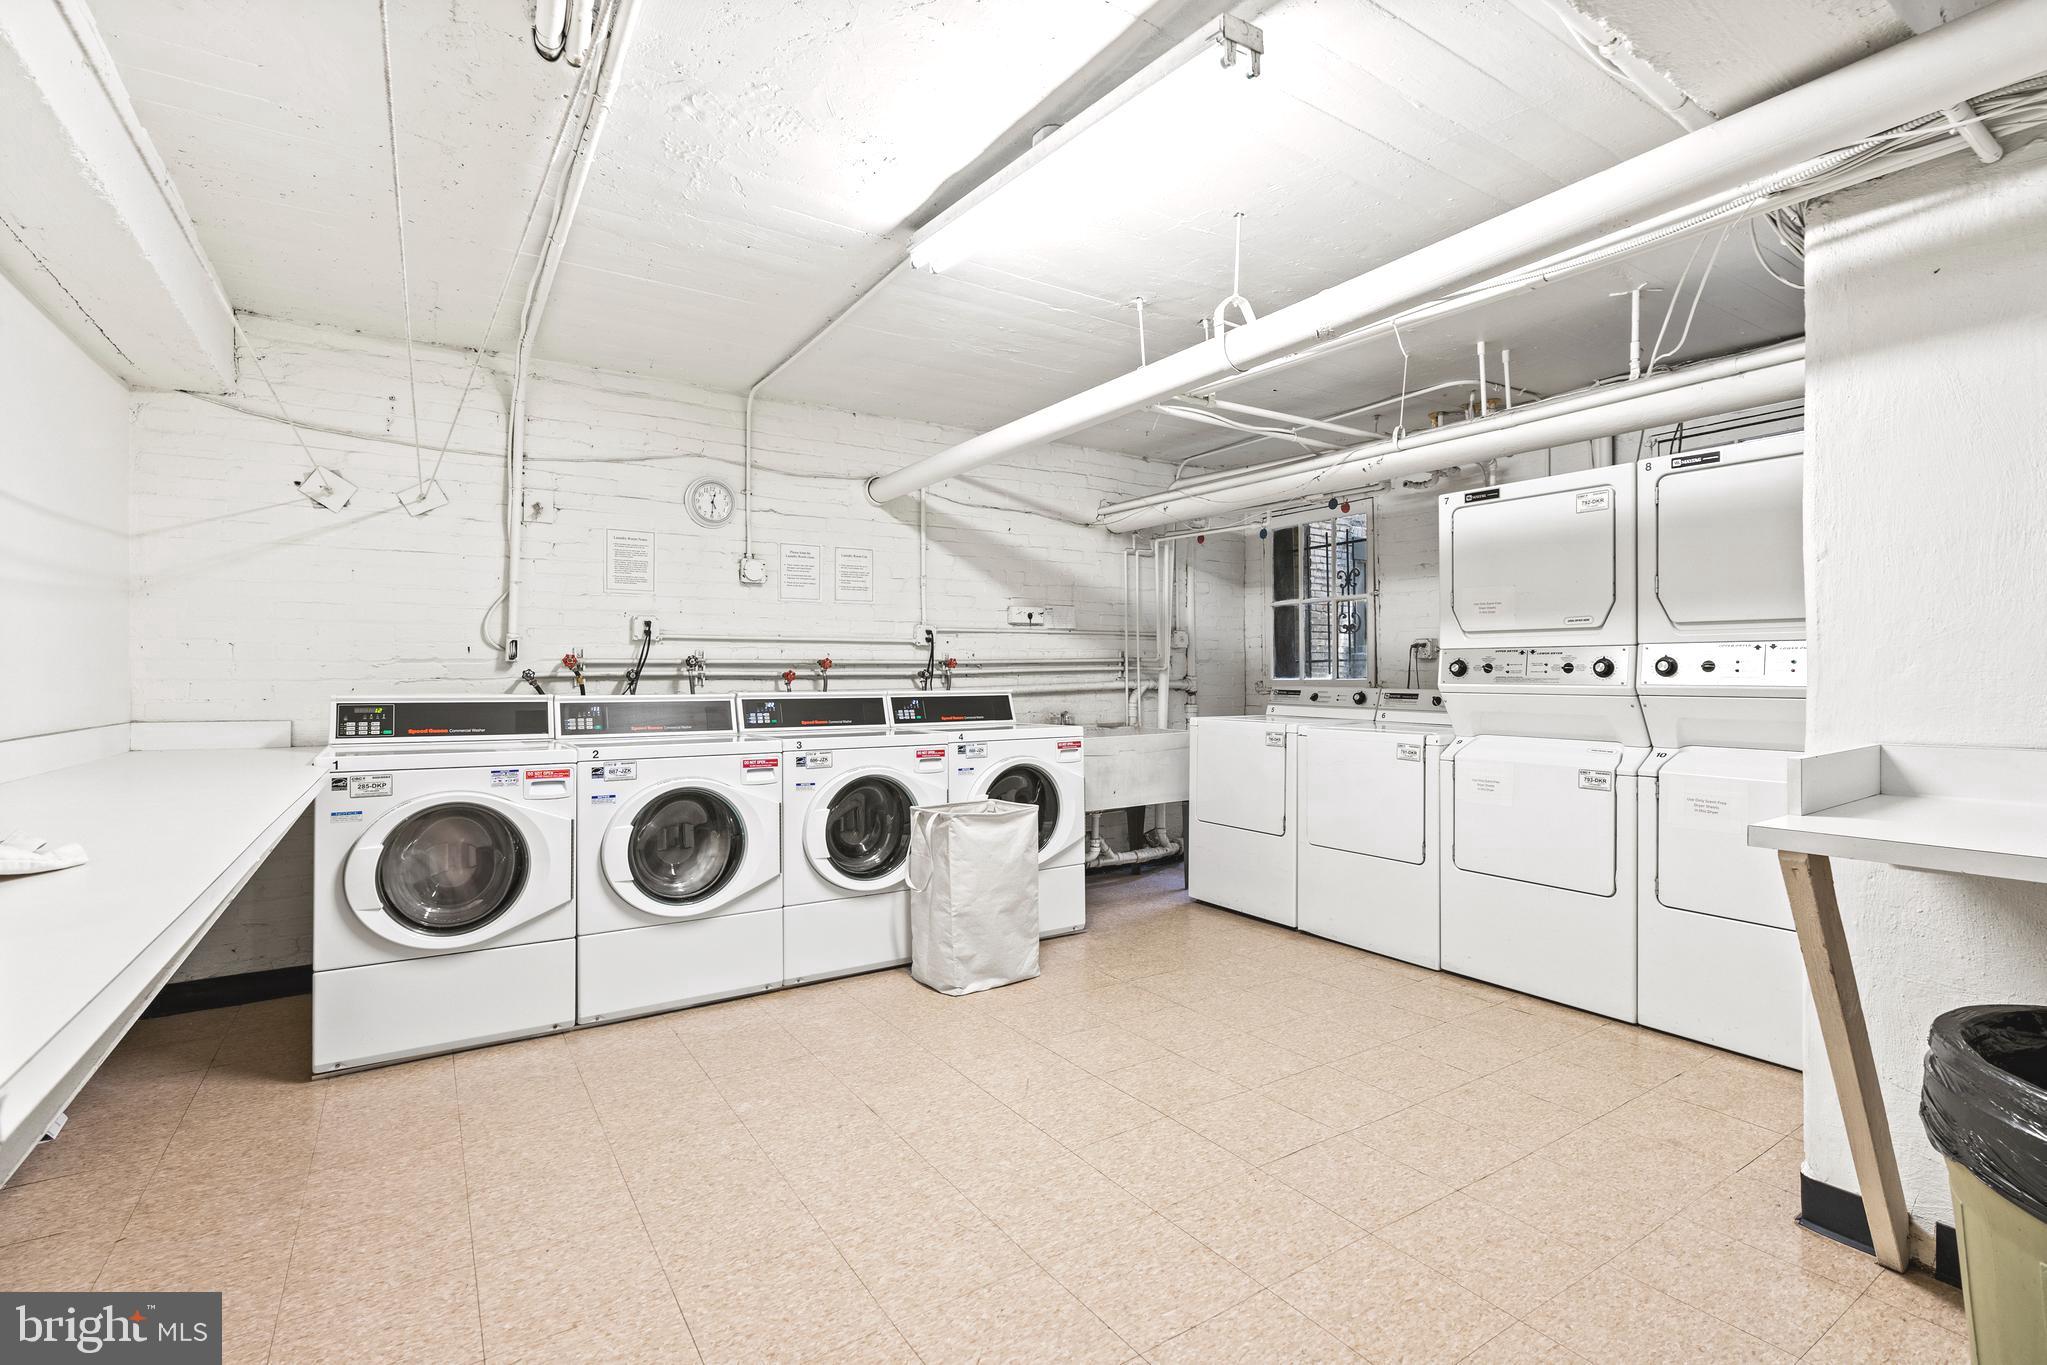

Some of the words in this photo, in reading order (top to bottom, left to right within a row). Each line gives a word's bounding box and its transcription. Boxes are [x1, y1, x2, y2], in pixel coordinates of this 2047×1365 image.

[1645, 462, 1652, 472] 8
[592, 750, 599, 758] 2
[333, 761, 338, 770] 1
